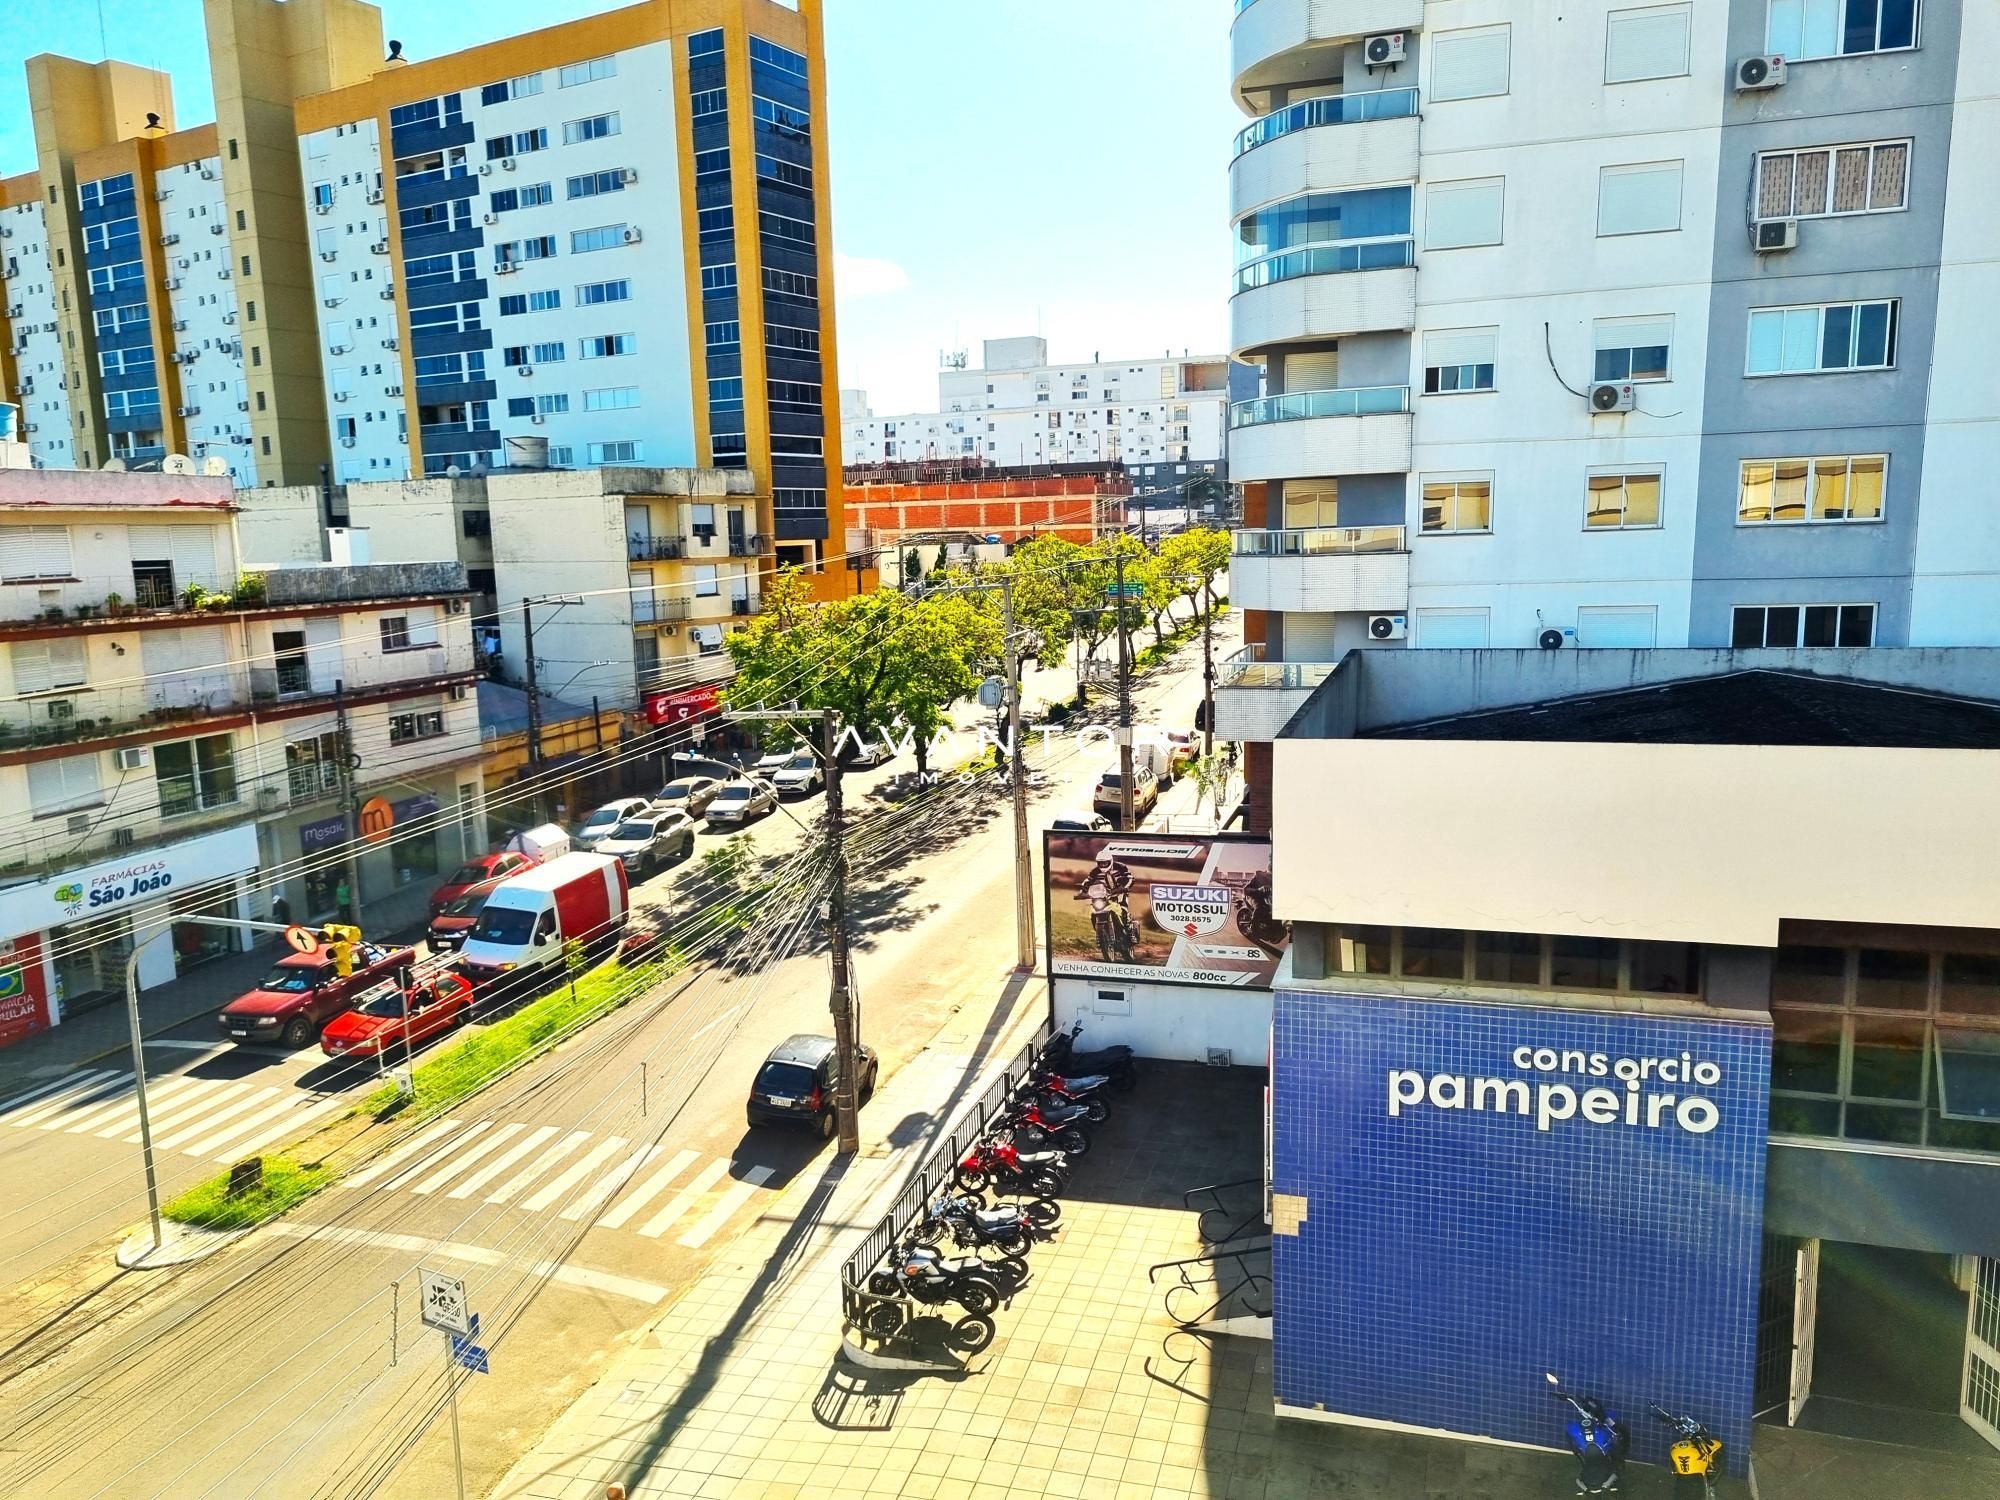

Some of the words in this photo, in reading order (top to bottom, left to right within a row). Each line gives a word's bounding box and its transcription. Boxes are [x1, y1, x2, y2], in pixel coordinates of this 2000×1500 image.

[91, 860, 166, 888] FARMÁCIAS
[89, 884, 125, 908] São
[129, 871, 172, 897] João
[1153, 887, 1228, 902] SUZUKI
[1155, 902, 1226, 915] MOTOSSUL
[1170, 915, 1212, 923] 3028.5575
[1057, 963, 1089, 973] VENHA
[1091, 965, 1142, 976] CONHECER
[1143, 969, 1156, 977] AS
[1158, 970, 1190, 979] NOVAS
[1192, 971, 1227, 982] 800cc
[1512, 1045, 1721, 1086] consorcio
[1387, 1069, 1720, 1134] pampeiro
